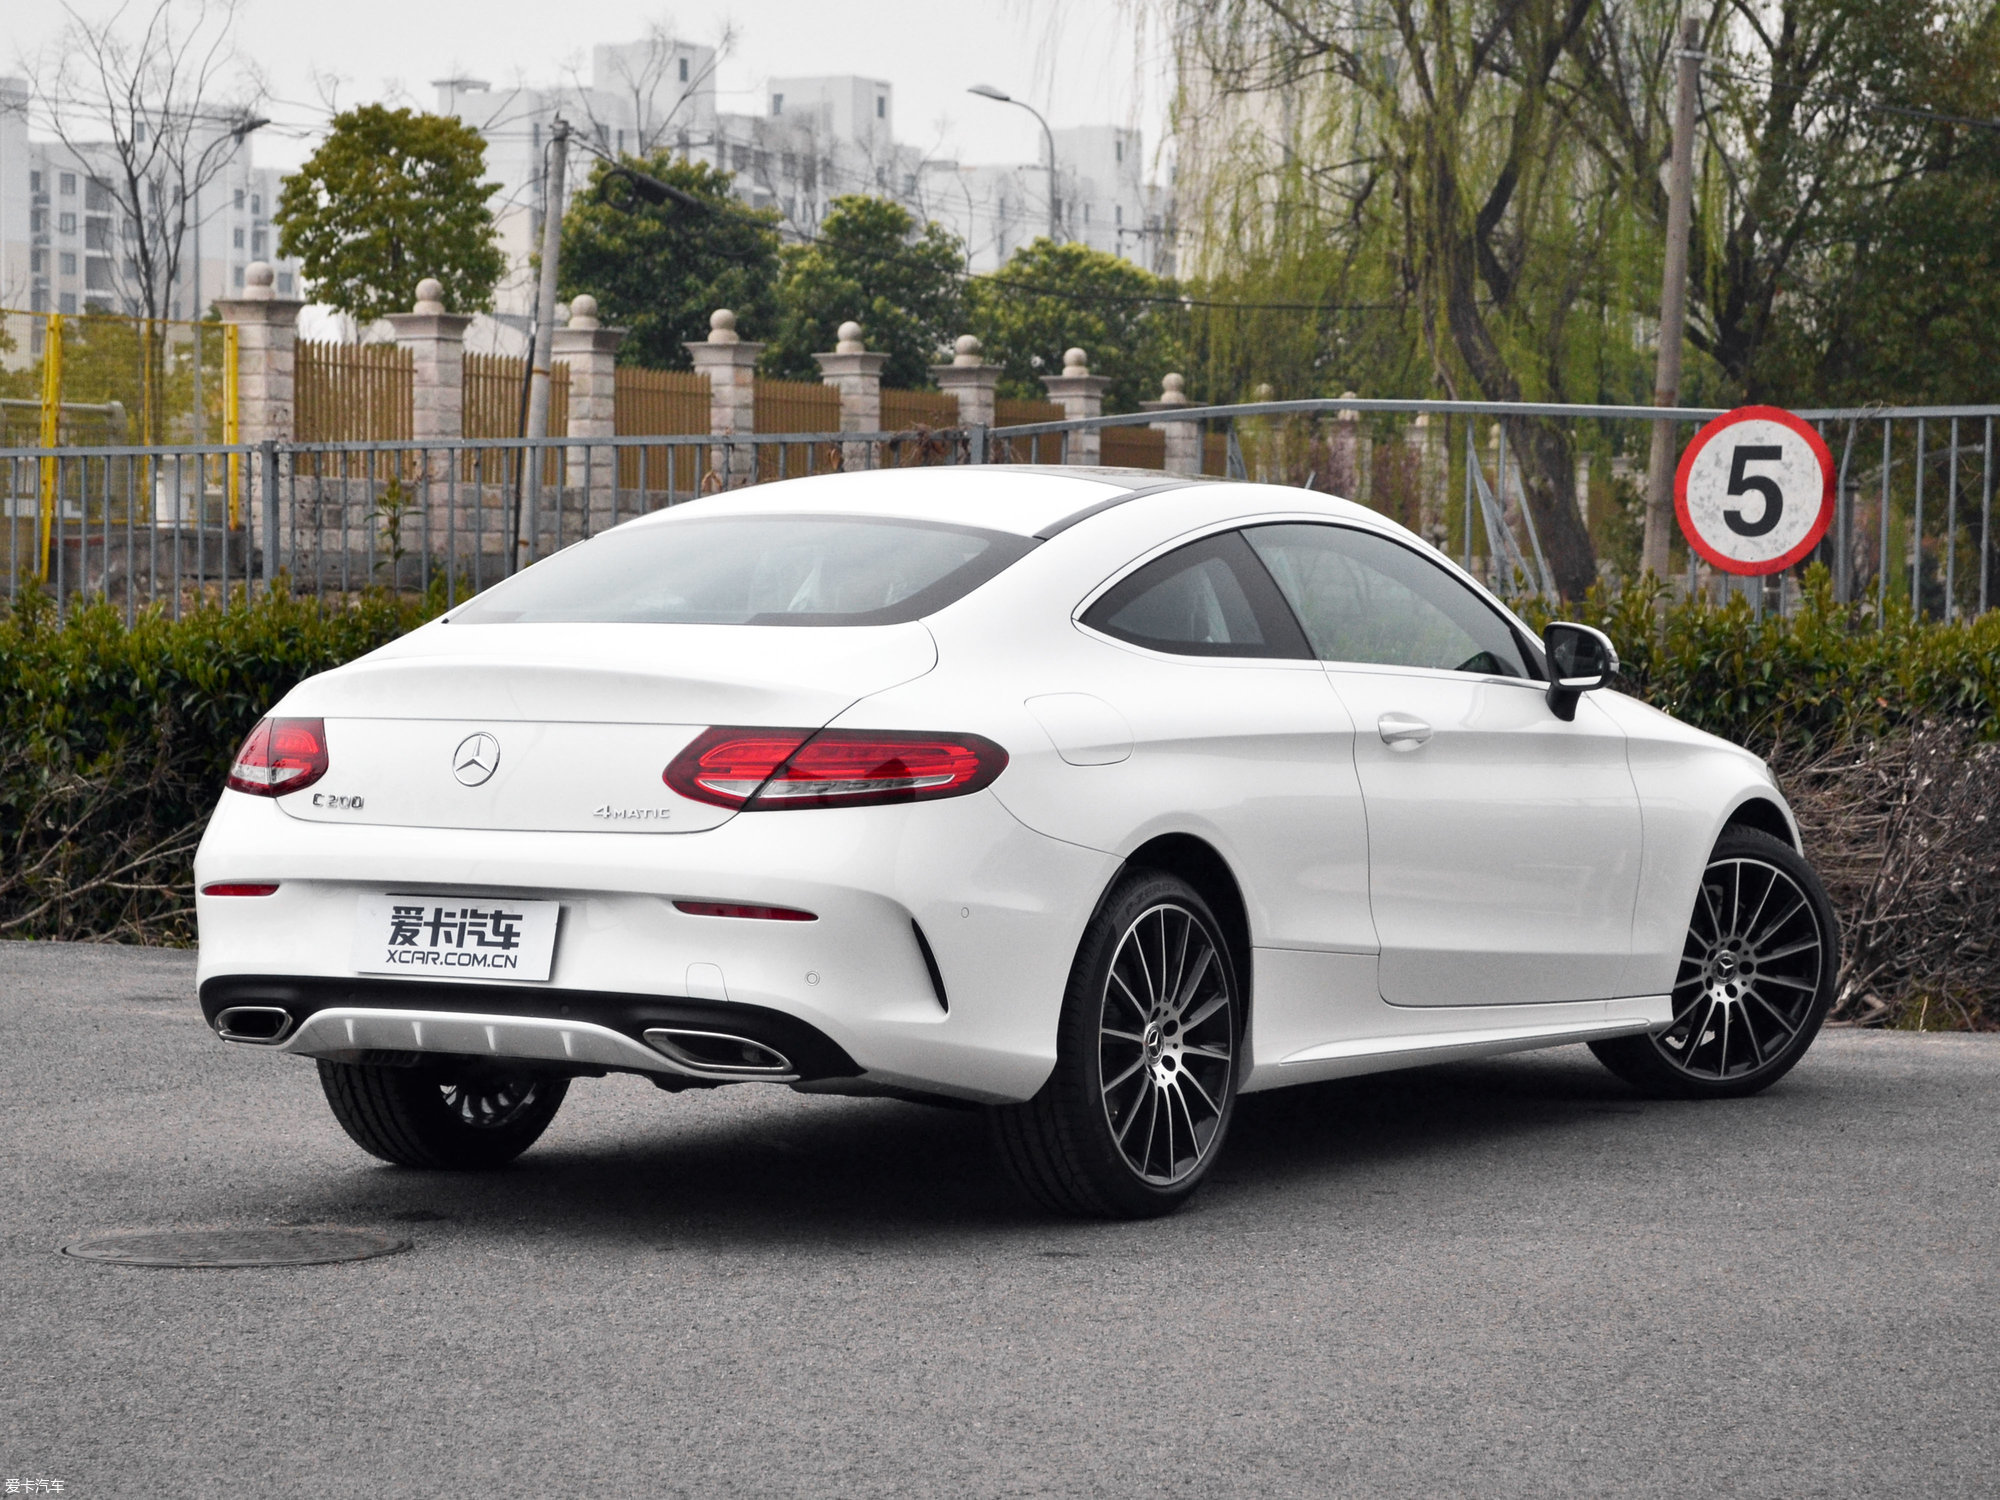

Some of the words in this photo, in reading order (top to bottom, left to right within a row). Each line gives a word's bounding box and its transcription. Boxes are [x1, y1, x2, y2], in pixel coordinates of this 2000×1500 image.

[1723, 445, 1783, 537] 5
[312, 793, 325, 807] C
[327, 794, 365, 809] 200
[592, 804, 671, 819] 4MATIC
[388, 906, 523, 950] 爱卡汽车
[386, 949, 518, 968] XCAR.COM.CN
